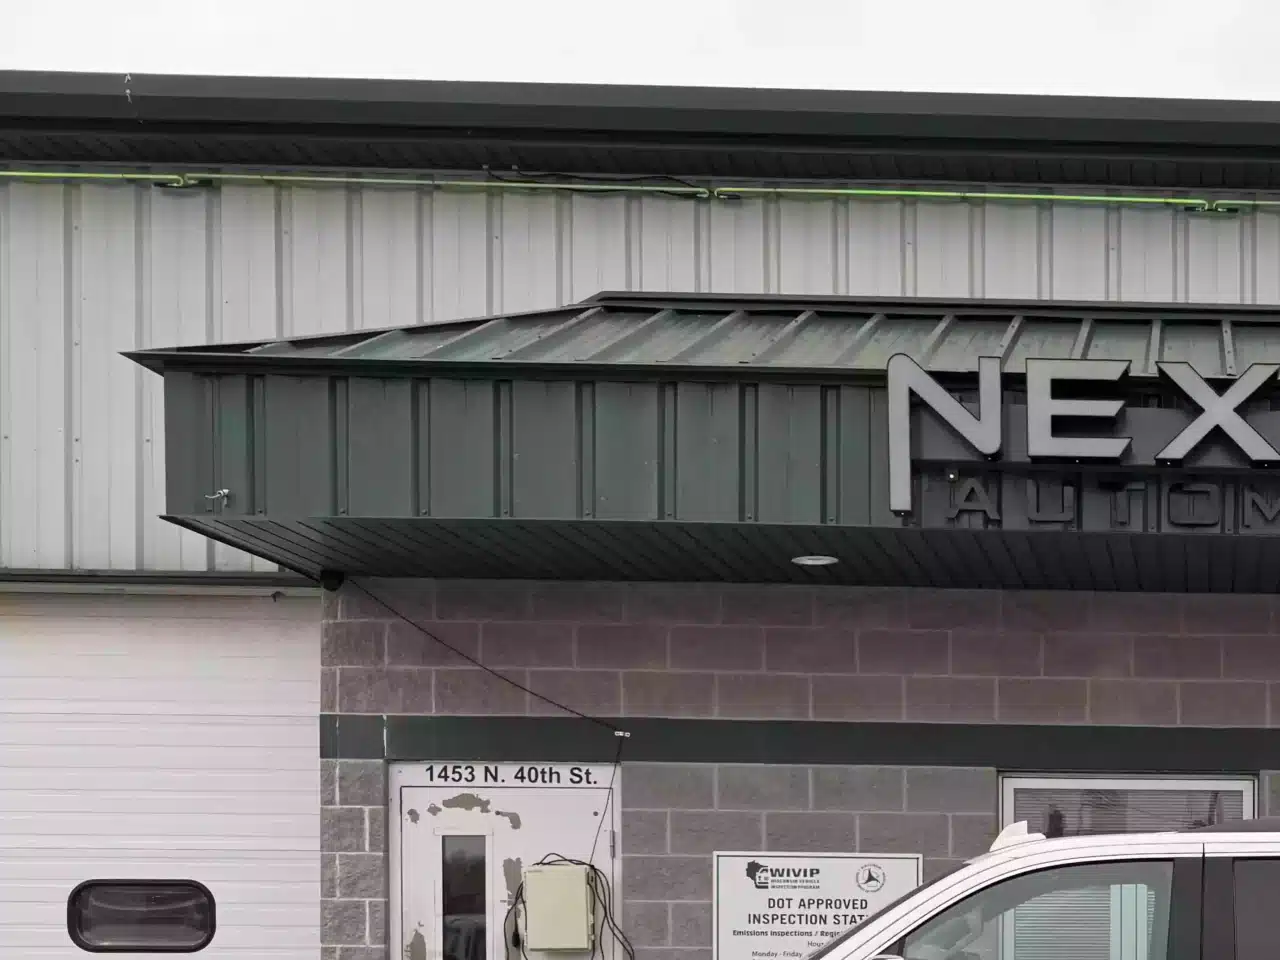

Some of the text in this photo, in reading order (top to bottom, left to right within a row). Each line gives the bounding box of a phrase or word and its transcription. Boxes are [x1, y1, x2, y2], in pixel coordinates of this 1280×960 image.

[425, 765, 598, 784] 1453 N. 40th St.
[770, 868, 820, 878] WIVIP
[768, 898, 868, 910] DOT APPROVED
[748, 913, 869, 925] INSPECTION STAT
